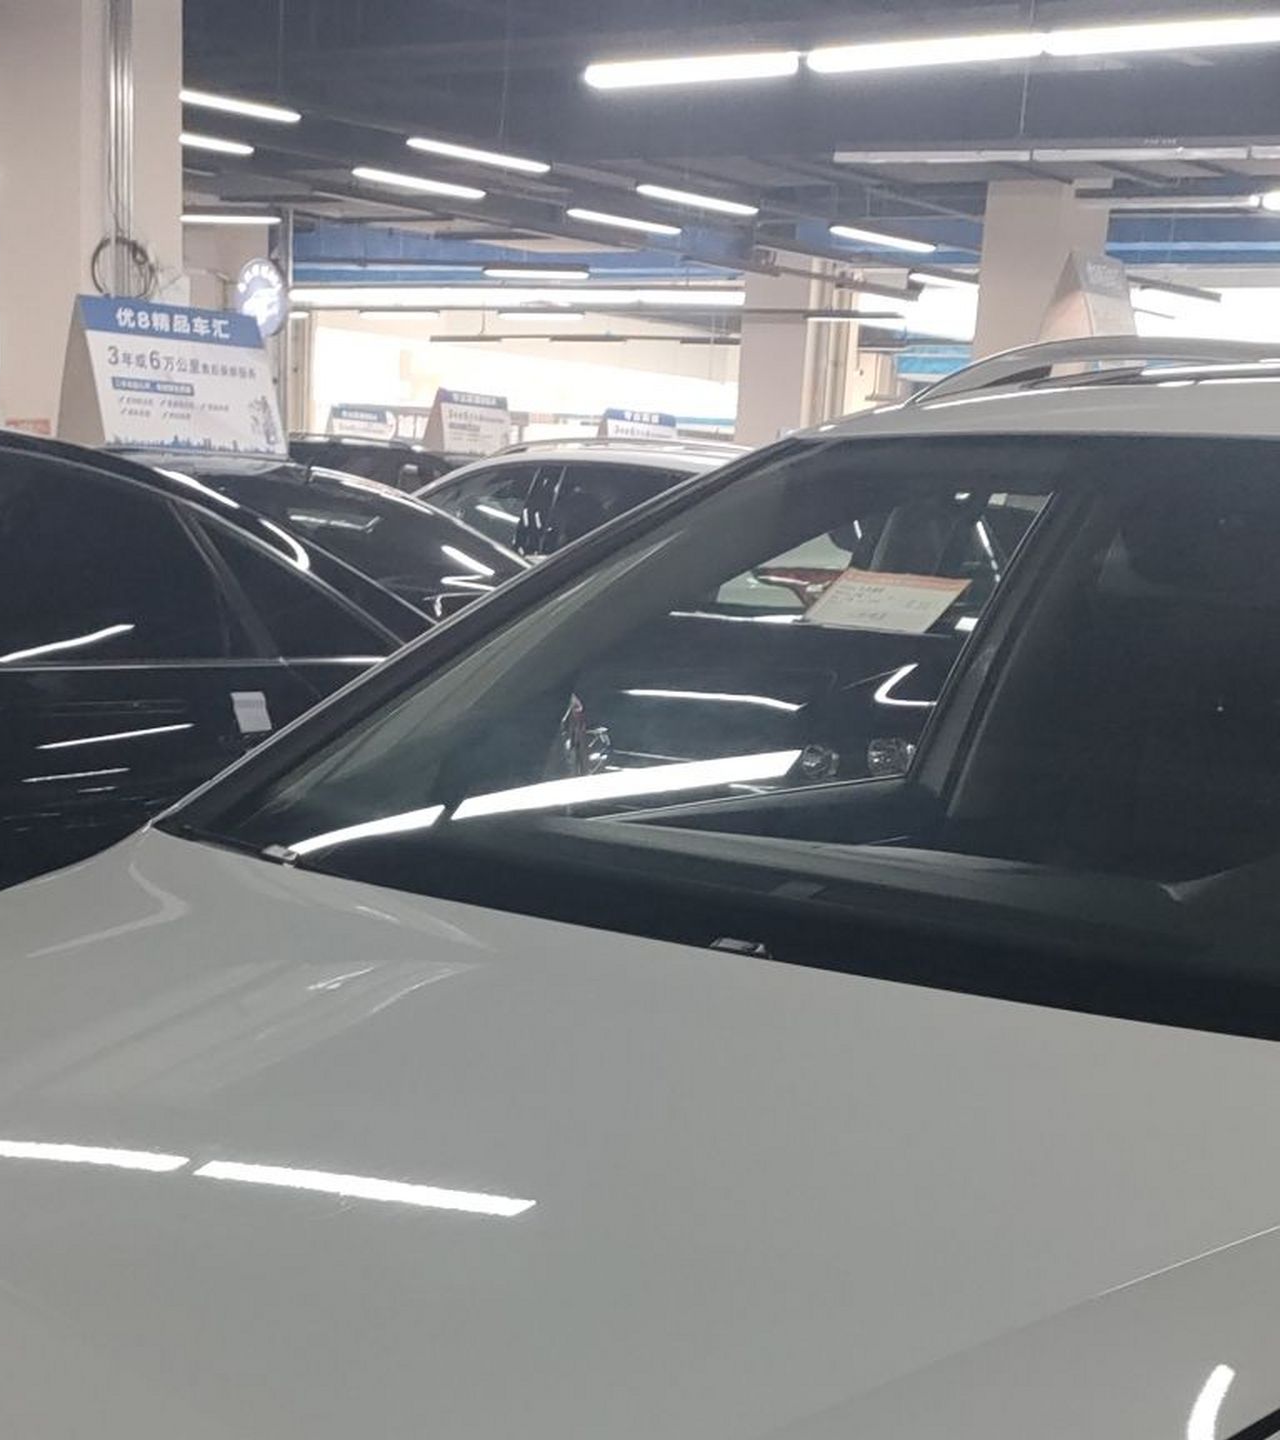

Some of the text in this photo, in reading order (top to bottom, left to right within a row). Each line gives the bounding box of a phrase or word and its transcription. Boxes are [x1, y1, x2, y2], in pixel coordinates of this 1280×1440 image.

[116, 307, 230, 339] 优8精品车汇
